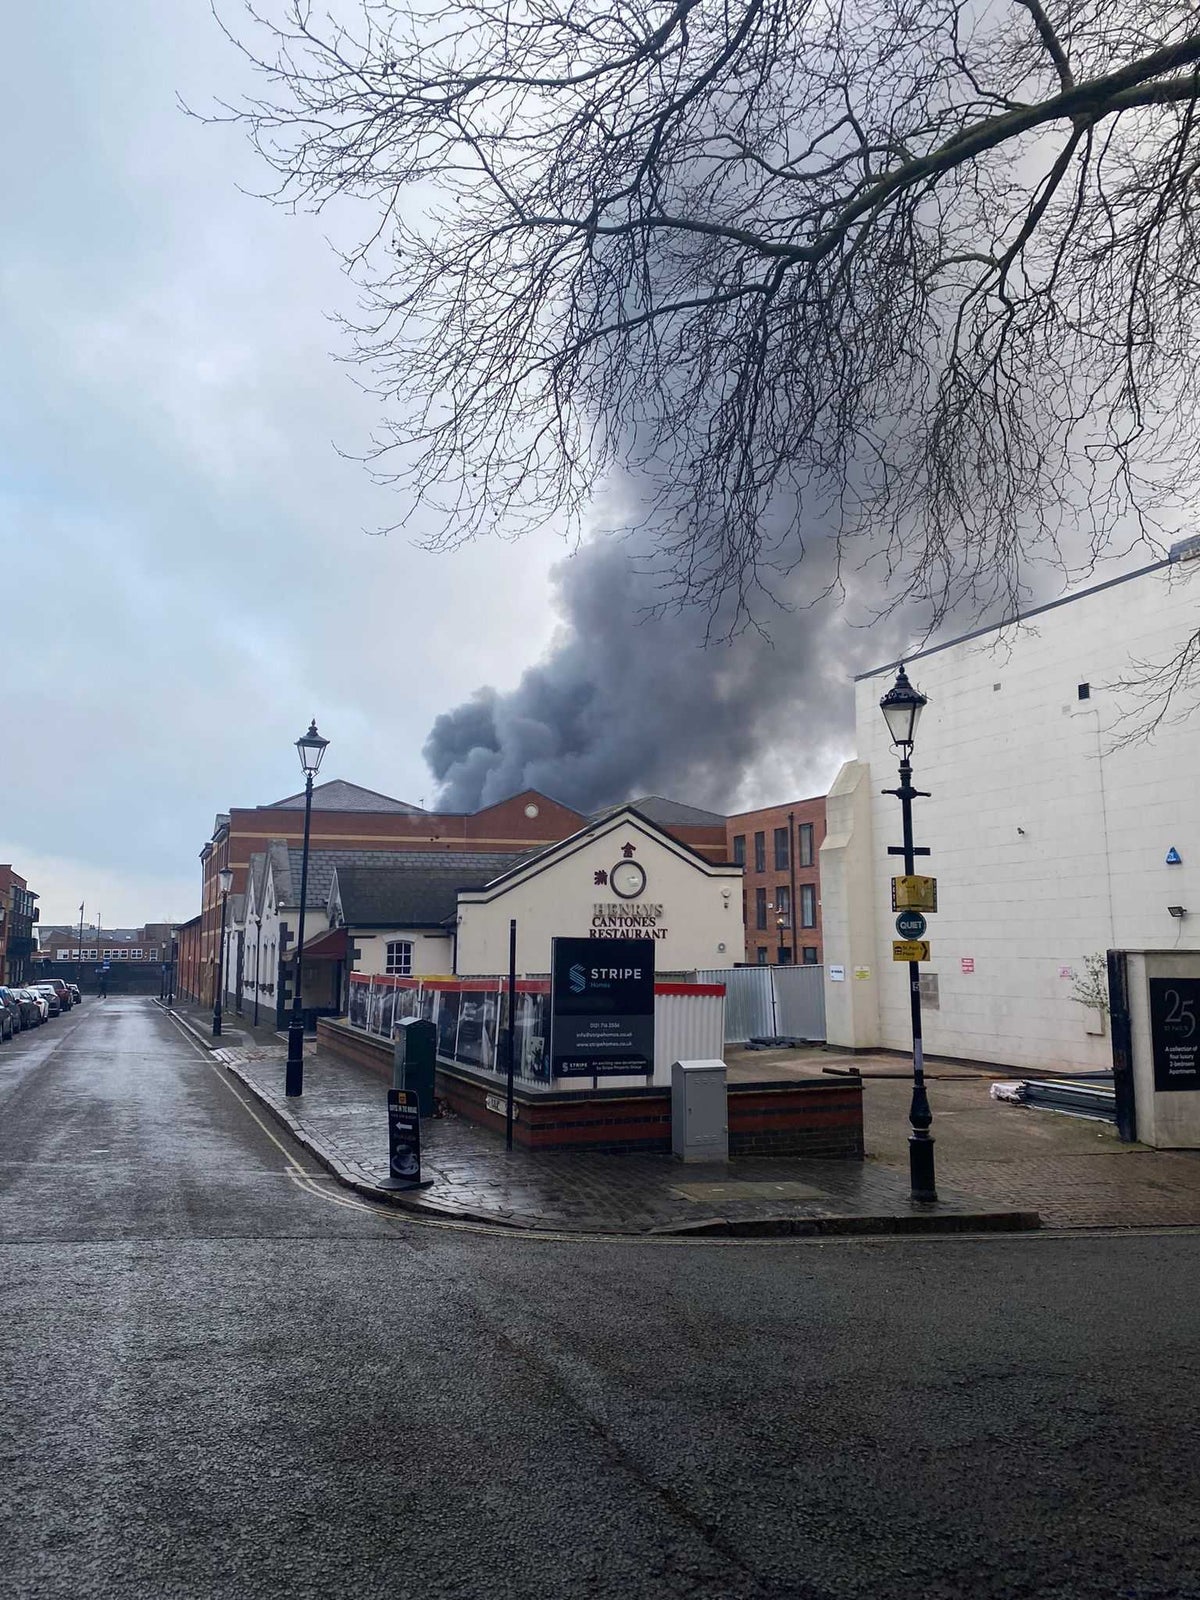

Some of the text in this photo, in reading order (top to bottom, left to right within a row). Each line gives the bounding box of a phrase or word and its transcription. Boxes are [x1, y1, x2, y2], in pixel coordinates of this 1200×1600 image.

[592, 916, 656, 927] CANTONES
[589, 928, 668, 939] RESTAURANT
[591, 968, 642, 980] STRIPE
[1164, 989, 1196, 1038] 25
